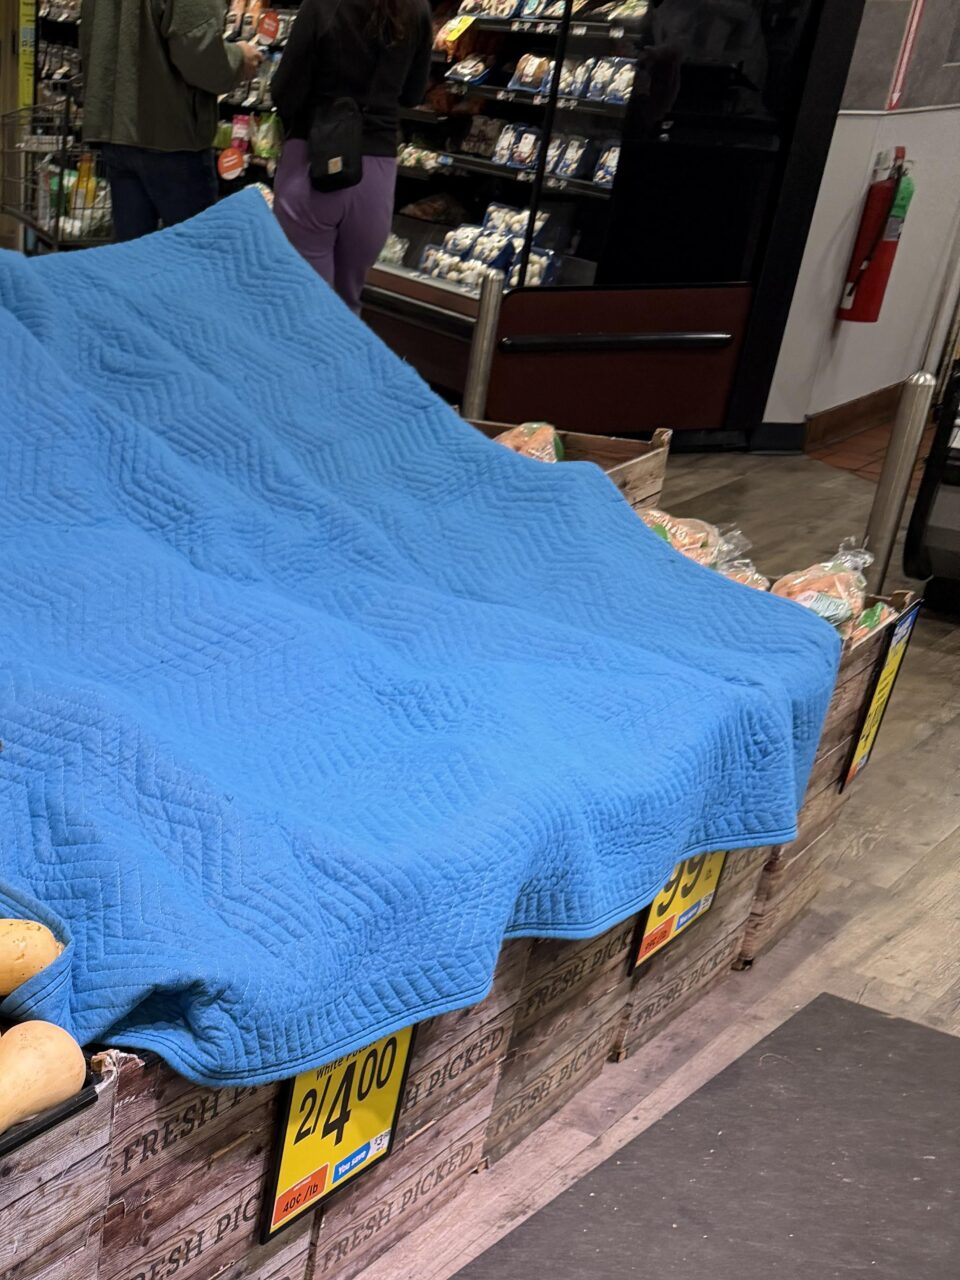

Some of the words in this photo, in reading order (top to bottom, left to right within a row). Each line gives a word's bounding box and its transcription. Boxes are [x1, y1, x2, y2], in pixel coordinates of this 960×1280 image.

[426, 1026, 505, 1100] PICKED
[120, 1089, 220, 1177] FRESH
[321, 1201, 397, 1273] FRESH
[398, 1142, 474, 1214] PICKED
